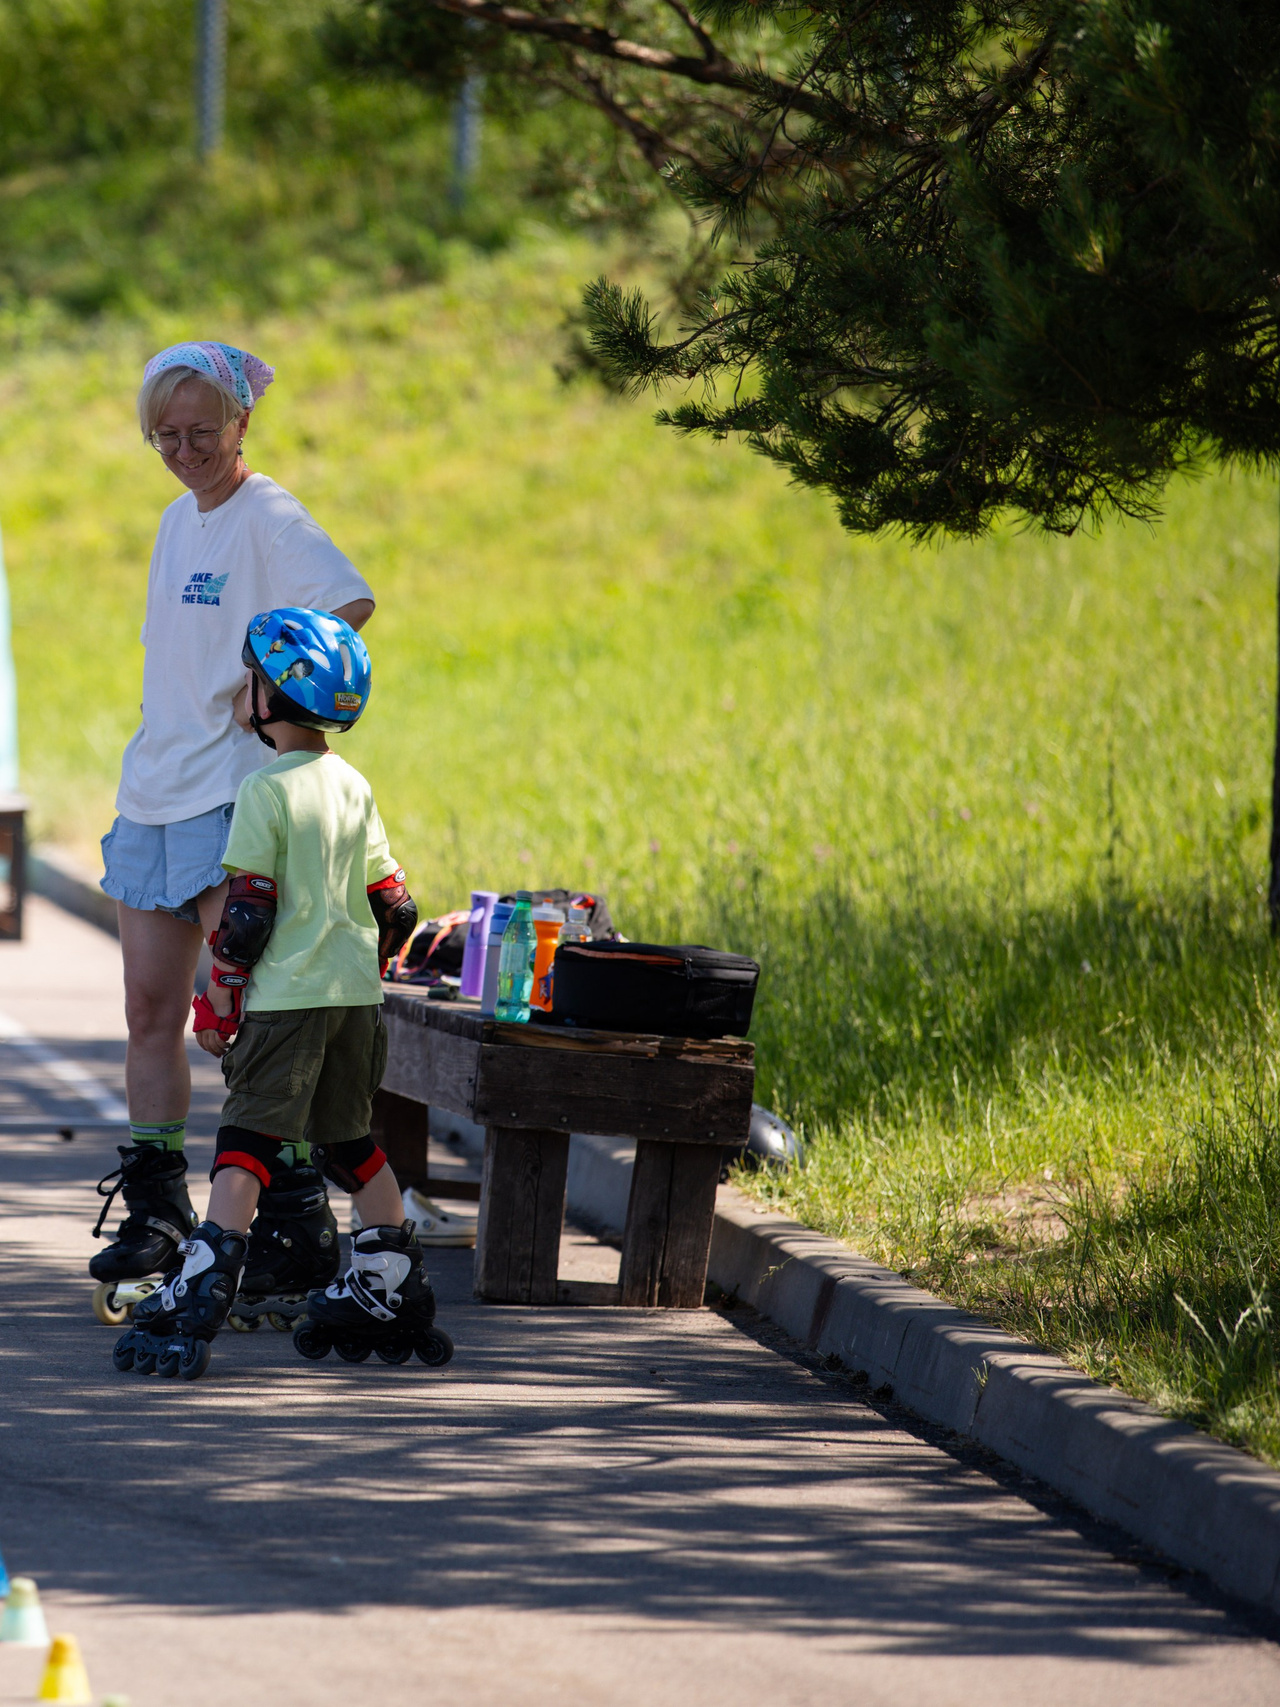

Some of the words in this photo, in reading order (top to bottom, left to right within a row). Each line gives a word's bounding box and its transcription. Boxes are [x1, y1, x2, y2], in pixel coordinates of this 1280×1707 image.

[188, 572, 213, 583] AKE
[181, 594, 195, 604] THE
[196, 595, 220, 606] SEA
